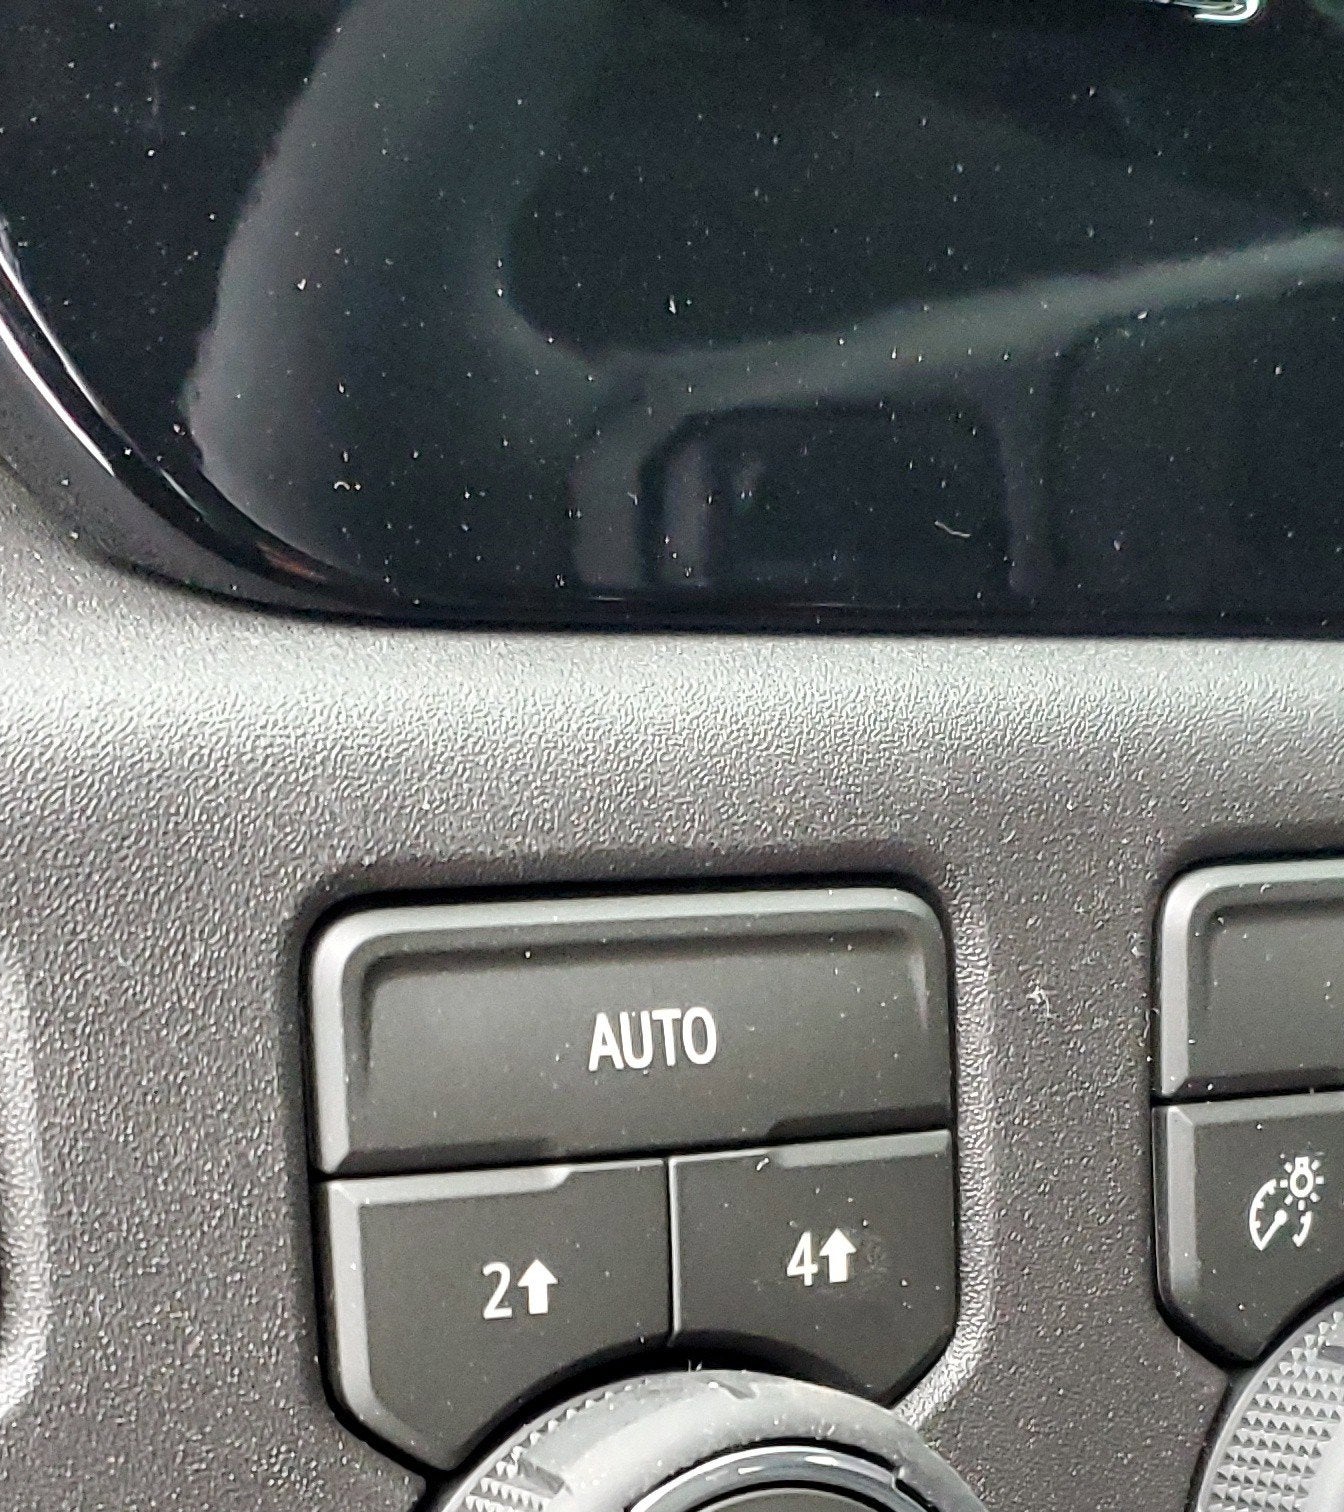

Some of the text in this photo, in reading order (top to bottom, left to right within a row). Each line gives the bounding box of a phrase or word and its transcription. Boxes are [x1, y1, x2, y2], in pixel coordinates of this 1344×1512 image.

[587, 1006, 718, 1072] AUTO
[785, 1231, 819, 1287] 4
[481, 1263, 513, 1321] 2
